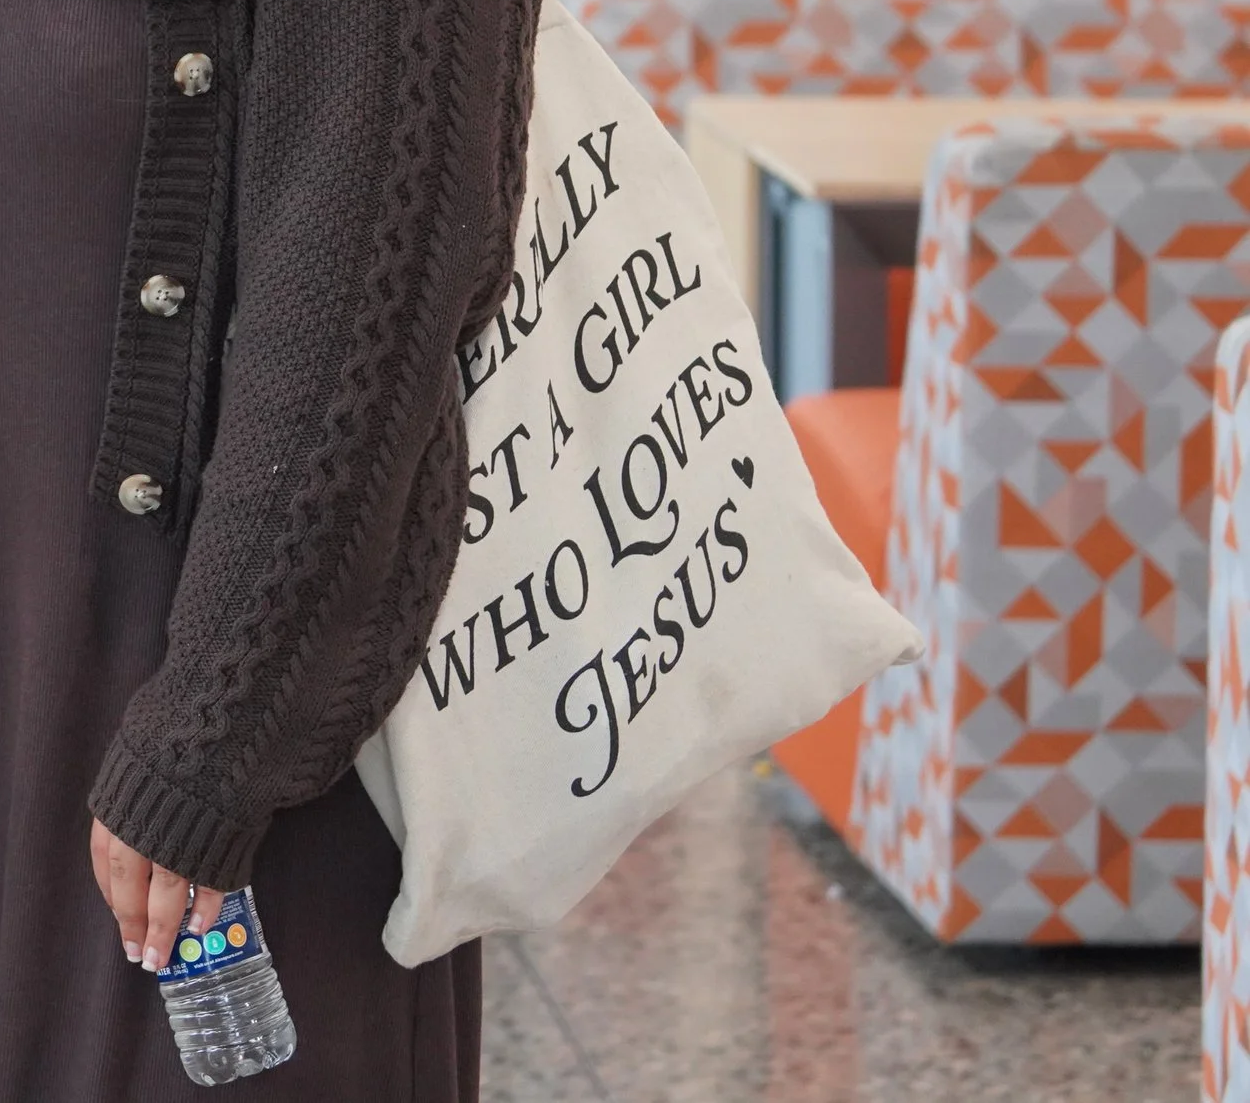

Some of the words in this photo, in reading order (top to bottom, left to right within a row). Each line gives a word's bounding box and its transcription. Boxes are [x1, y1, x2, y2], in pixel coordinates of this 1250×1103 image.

[547, 379, 574, 470] A
[574, 231, 701, 394] GIRL
[420, 539, 589, 712] WHO
[583, 338, 753, 568] LOVES
[554, 497, 749, 798] JESUS
